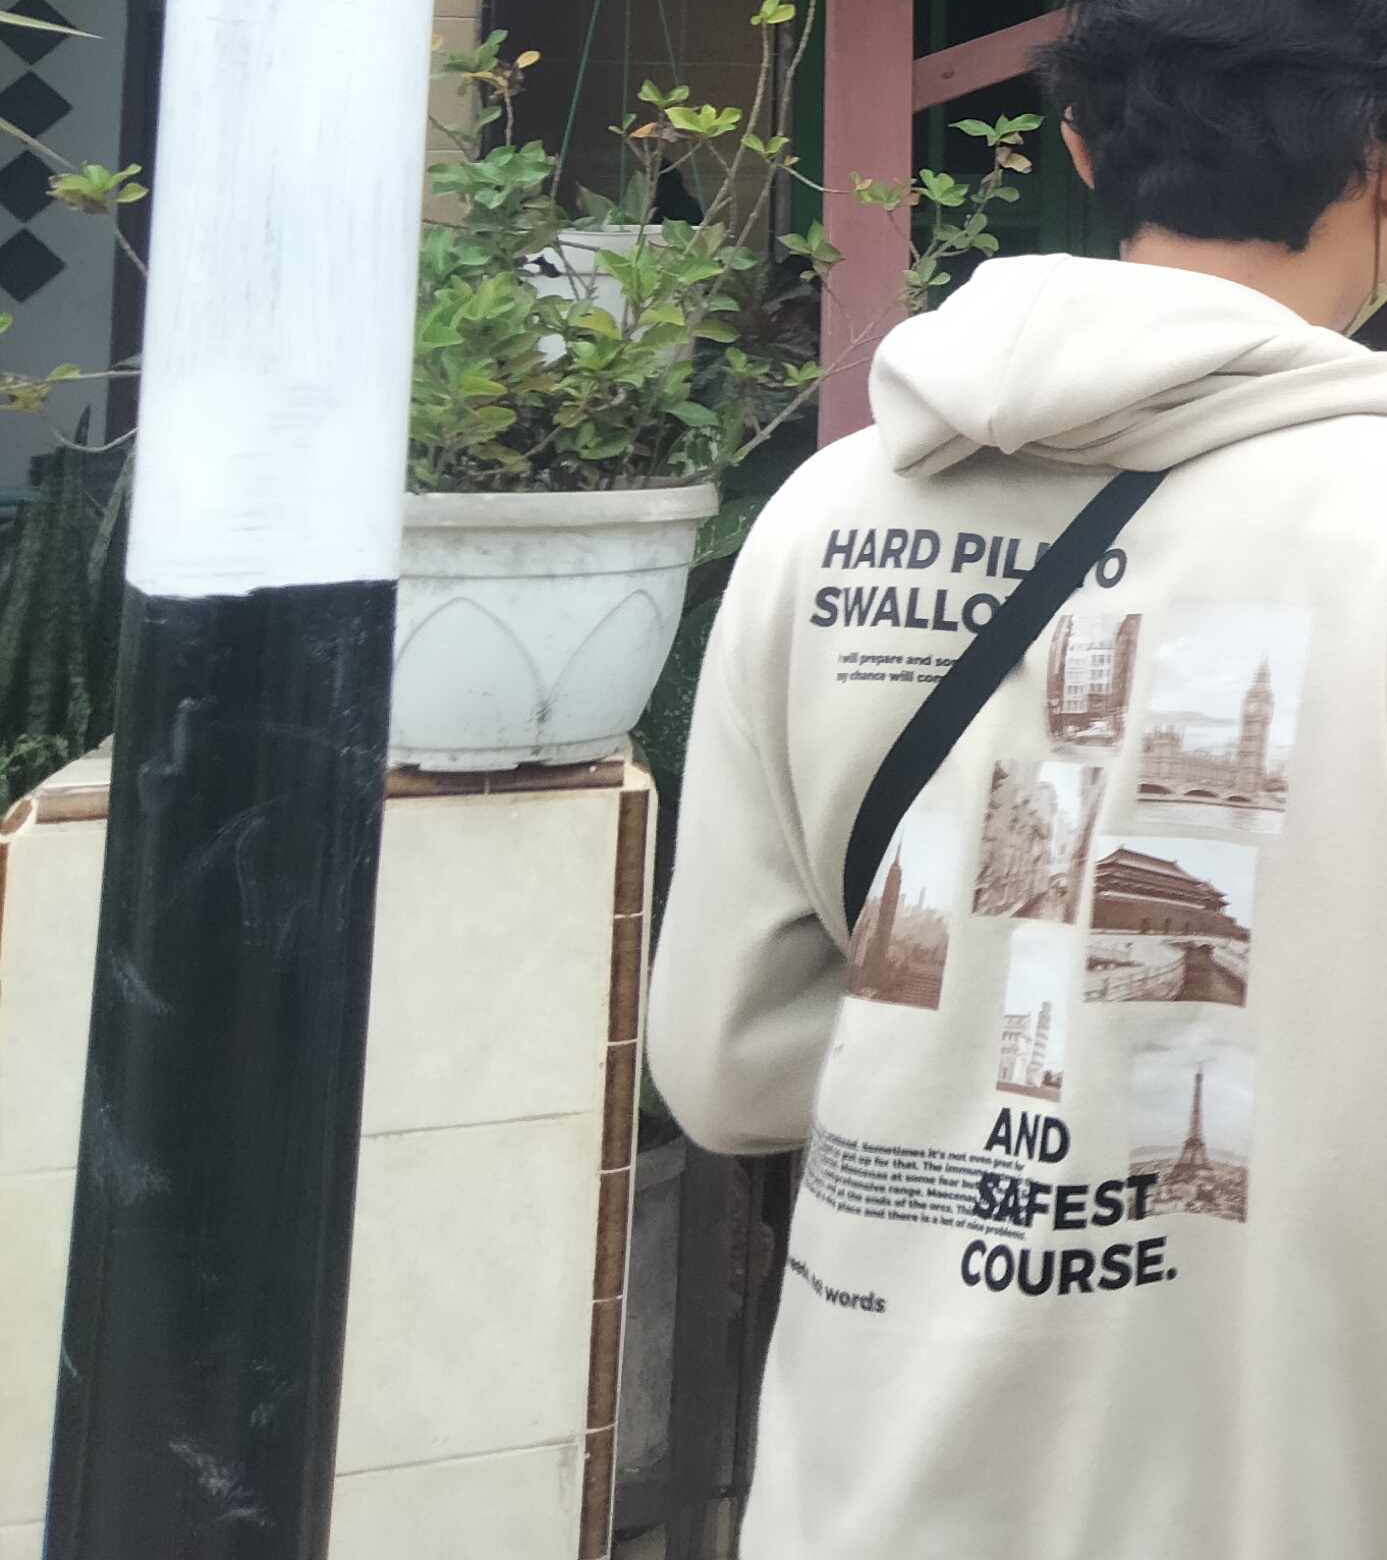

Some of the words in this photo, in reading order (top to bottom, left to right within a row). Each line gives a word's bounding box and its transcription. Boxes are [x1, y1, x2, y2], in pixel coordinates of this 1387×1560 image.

[821, 528, 941, 570] HARD
[951, 532, 1051, 580] PIL
[810, 586, 1012, 635] SWALLO
[859, 654, 903, 666] prepare
[906, 654, 932, 666] and
[889, 669, 914, 682] will
[983, 1107, 1070, 1164] AND
[923, 1161, 942, 1173] The
[974, 1172, 1160, 1231] SAFEST
[961, 1235, 1178, 1297] COURSE.
[824, 1285, 887, 1314] words
